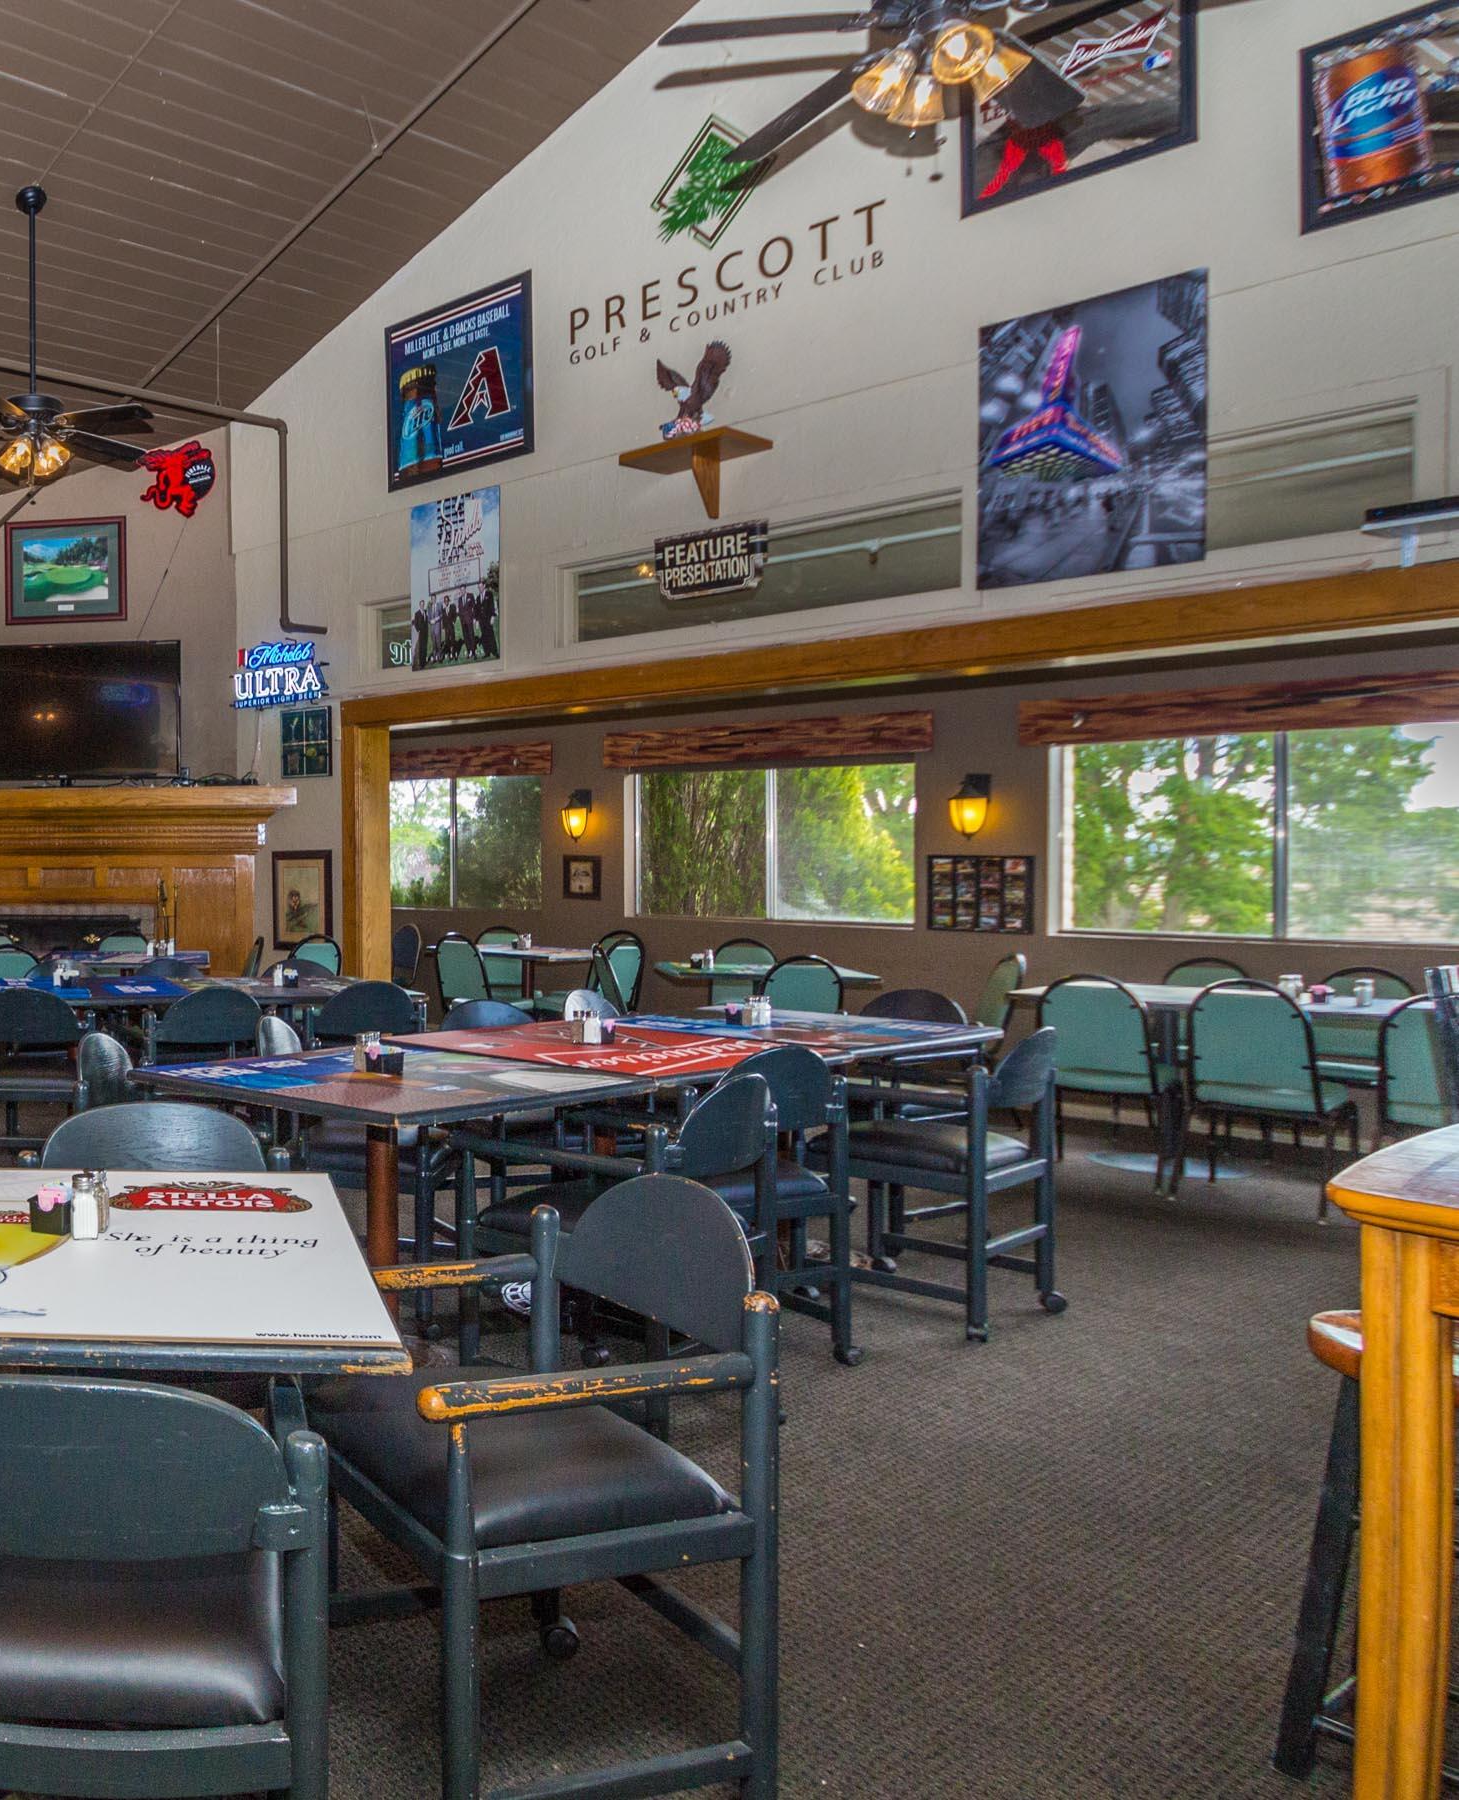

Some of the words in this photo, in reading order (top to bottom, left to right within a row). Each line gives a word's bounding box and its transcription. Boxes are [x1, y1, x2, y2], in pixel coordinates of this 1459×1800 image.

[1331, 89, 1417, 133] LIGHT
[1343, 77, 1410, 112] BUD
[570, 200, 886, 345] PRESCOTT
[570, 336, 620, 365] GOLF
[640, 328, 650, 342] &
[670, 282, 783, 332] COUNTRY
[814, 250, 884, 286] CLUB
[405, 332, 427, 356] MILLER
[427, 331, 440, 348] LITE
[443, 329, 449, 341] &
[477, 304, 510, 327] BASEBALL
[423, 346, 435, 360] MORE
[436, 343, 442, 355] TO
[453, 338, 466, 350] MORE
[467, 333, 474, 344] TO
[664, 532, 748, 566] FEATURE
[665, 555, 748, 589] PRESENTATION
[249, 642, 312, 668] Michelob
[234, 664, 320, 699] ULTRA
[235, 697, 269, 708] SUPERIOR
[273, 695, 295, 704] LIGHT
[299, 692, 319, 700] BEER
[145, 1199, 274, 1208] ARTOIS
[147, 1192, 271, 1200] STELLA
[104, 1232, 151, 1242] She
[173, 1234, 193, 1243] is
[237, 1234, 318, 1248] thing
[135, 1244, 169, 1257] of
[180, 1244, 288, 1259] beauty
